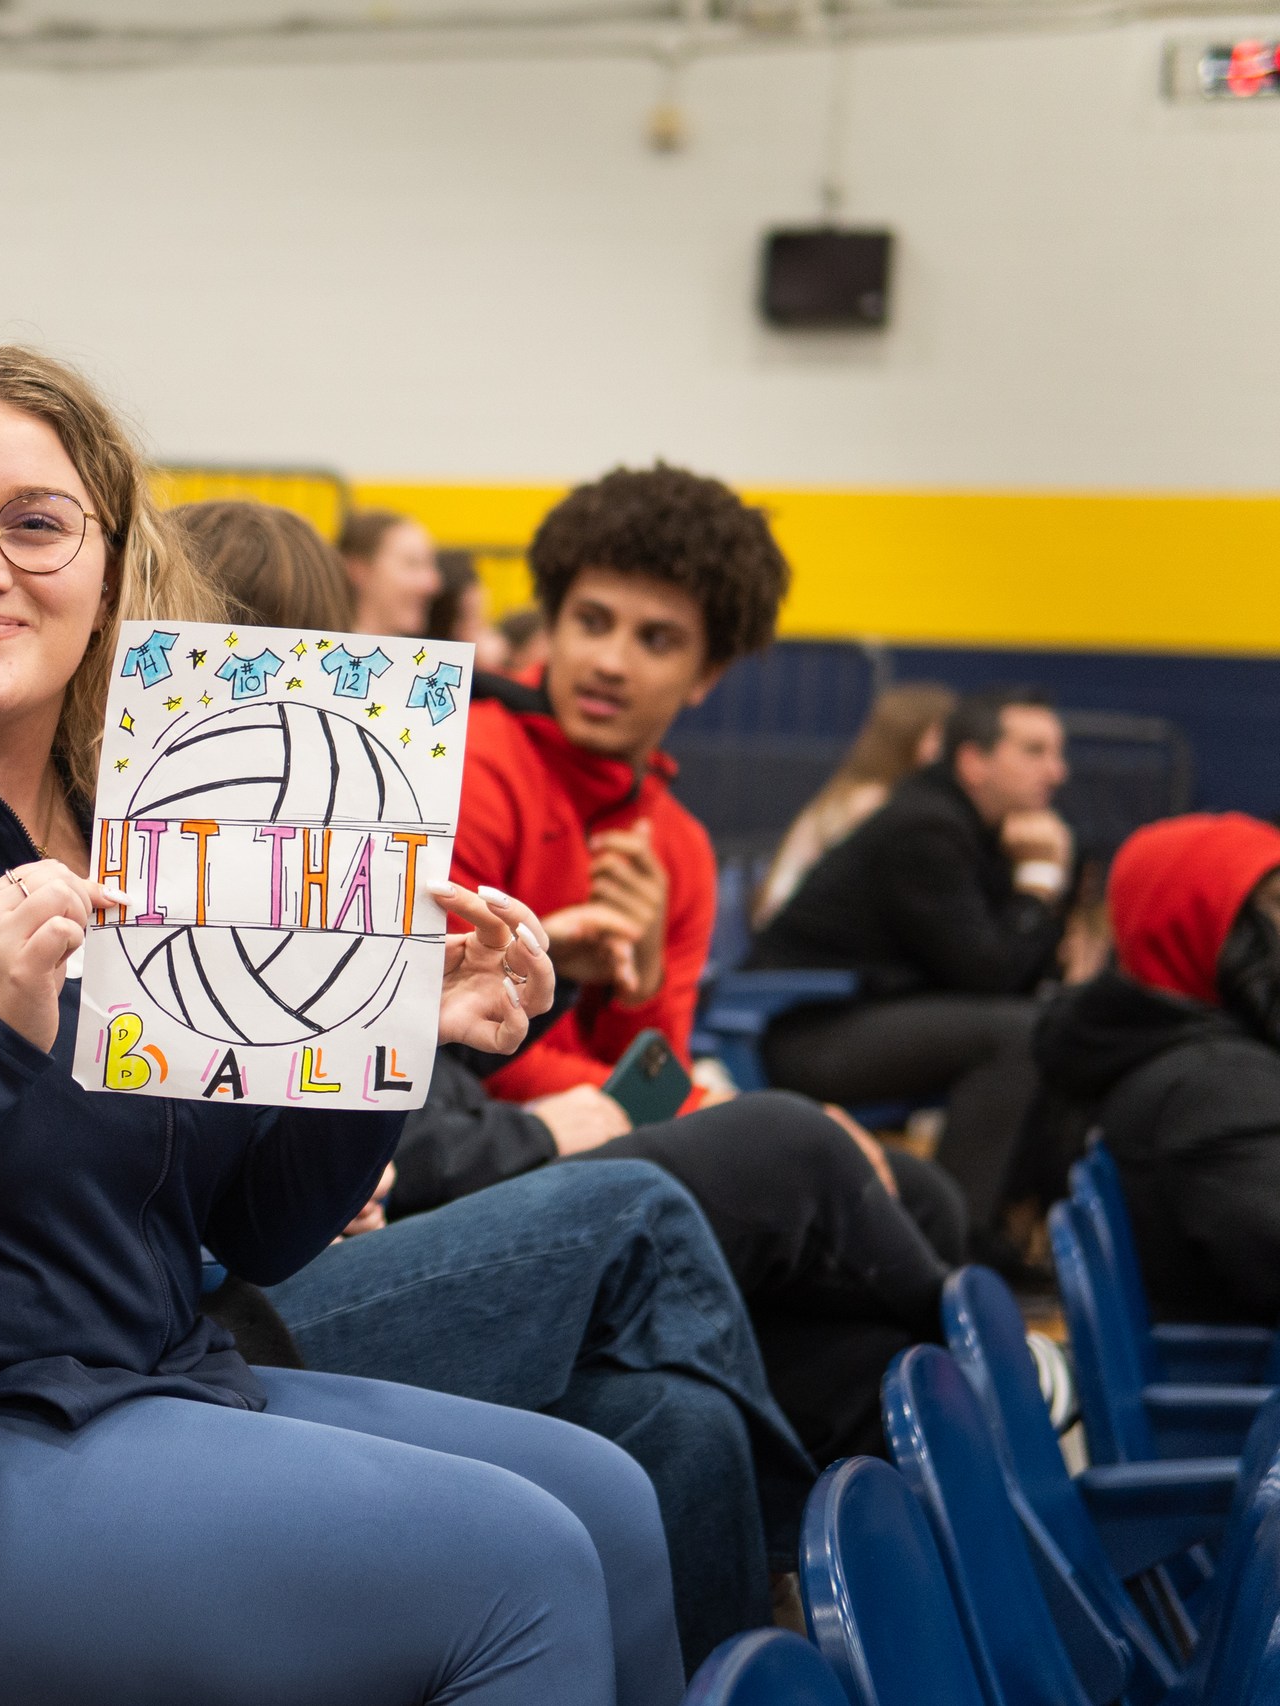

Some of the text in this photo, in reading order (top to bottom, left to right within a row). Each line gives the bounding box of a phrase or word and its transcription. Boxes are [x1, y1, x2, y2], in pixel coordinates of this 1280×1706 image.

[96, 818, 428, 937] HIT THAT
[103, 1012, 413, 1100] BALL
